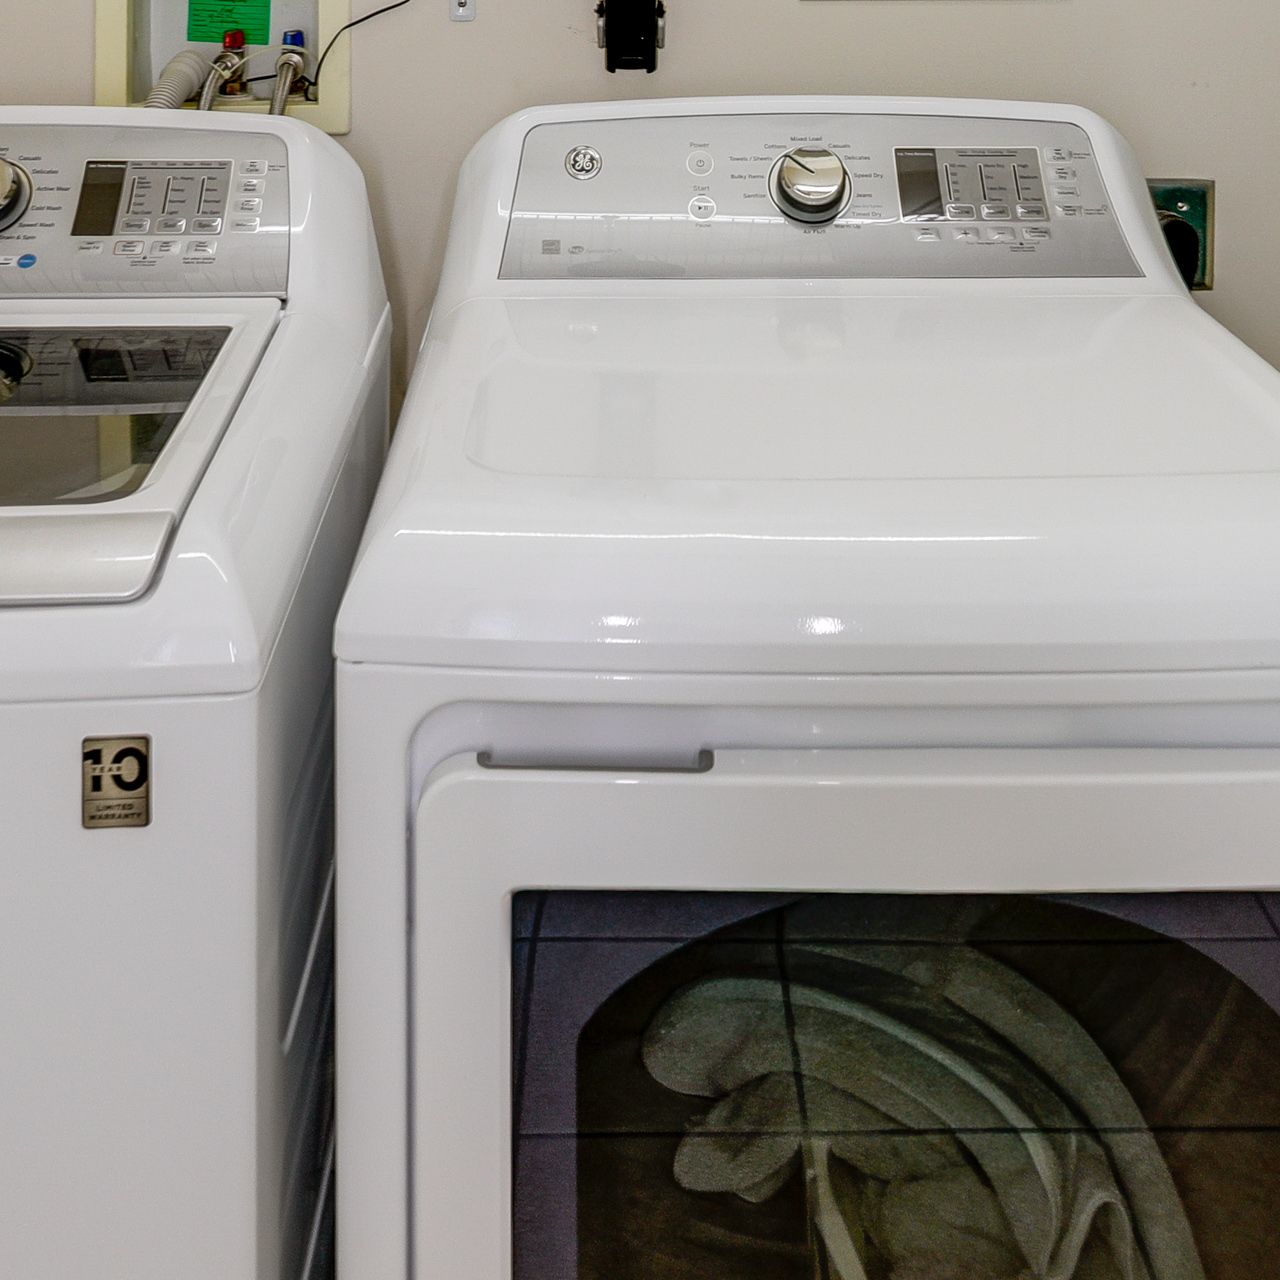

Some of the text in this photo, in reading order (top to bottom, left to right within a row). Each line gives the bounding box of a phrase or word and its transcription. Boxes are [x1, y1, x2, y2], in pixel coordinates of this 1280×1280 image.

[83, 747, 148, 792] 10
[96, 803, 134, 812] LIMITED
[89, 812, 142, 820] WARRANTY
